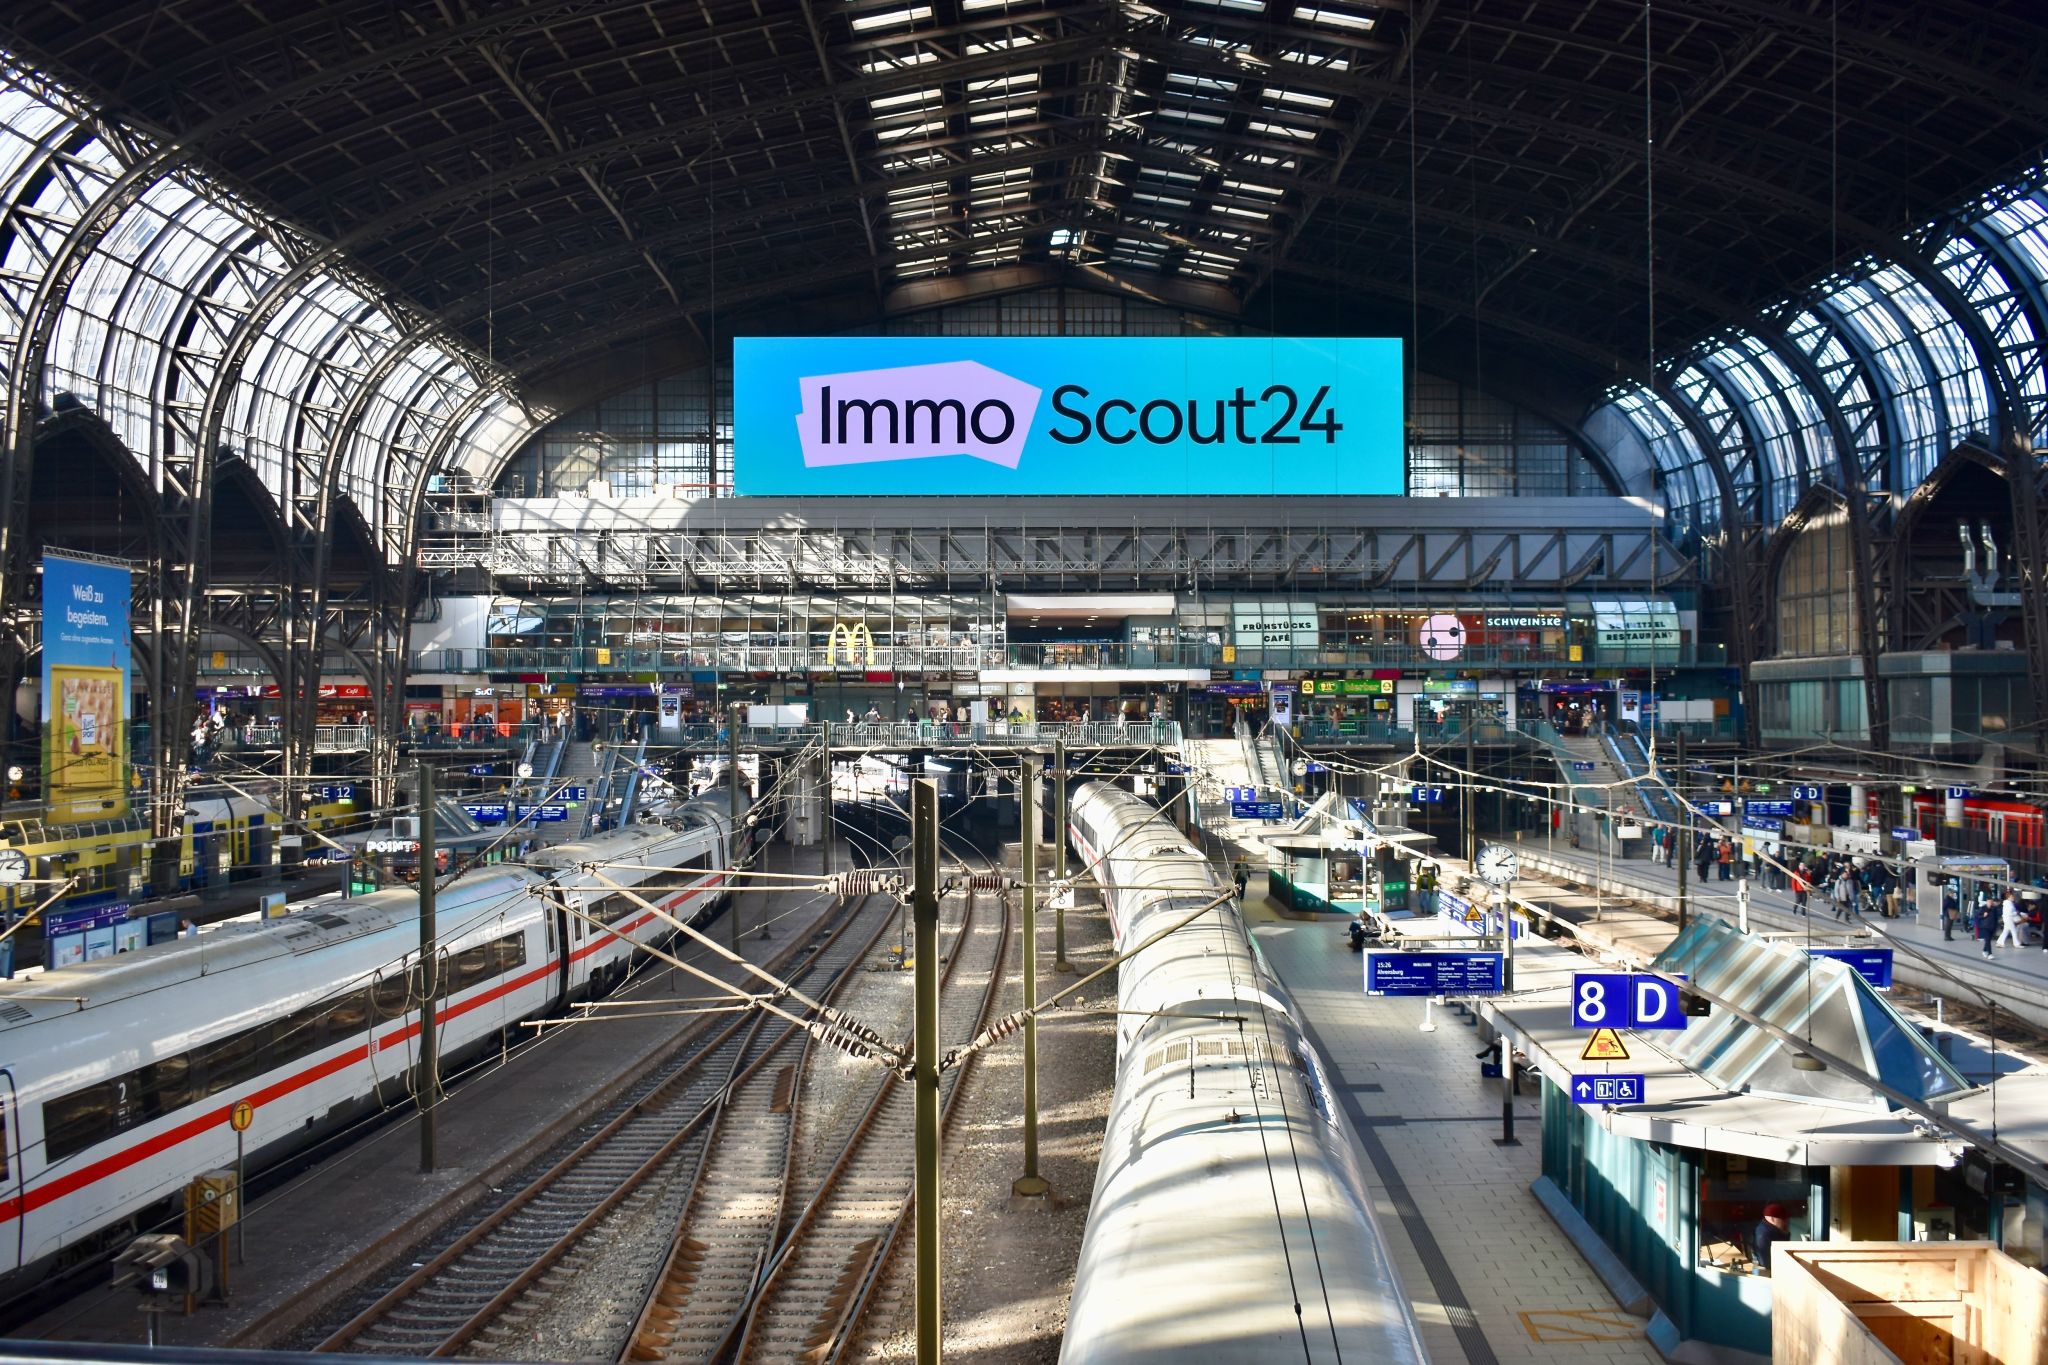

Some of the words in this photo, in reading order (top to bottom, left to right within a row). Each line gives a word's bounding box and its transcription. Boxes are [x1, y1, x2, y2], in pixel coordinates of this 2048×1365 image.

[820, 386, 1014, 444] Immo
[1048, 384, 1343, 444] Scout24
[73, 584, 93, 600] Weiß
[94, 592, 104, 603] zu
[1243, 621, 1311, 631] FRÜHSTÜCKS
[1264, 633, 1290, 642] CAFÉ
[322, 788, 329, 798] E
[337, 787, 351, 798] 12
[558, 787, 571, 799] 11
[578, 787, 585, 799] E
[1226, 789, 1234, 801] 8
[1241, 789, 1249, 801] E
[1418, 789, 1426, 800] E
[1434, 789, 1442, 800] 7
[1793, 789, 1801, 799] 6
[1809, 788, 1818, 799] D
[1954, 787, 1962, 797] D
[367, 841, 412, 853] POINT
[1578, 981, 1606, 1022] 8
[1636, 982, 1667, 1023] D
[119, 1082, 127, 1104] 2
[237, 1107, 249, 1127] T
